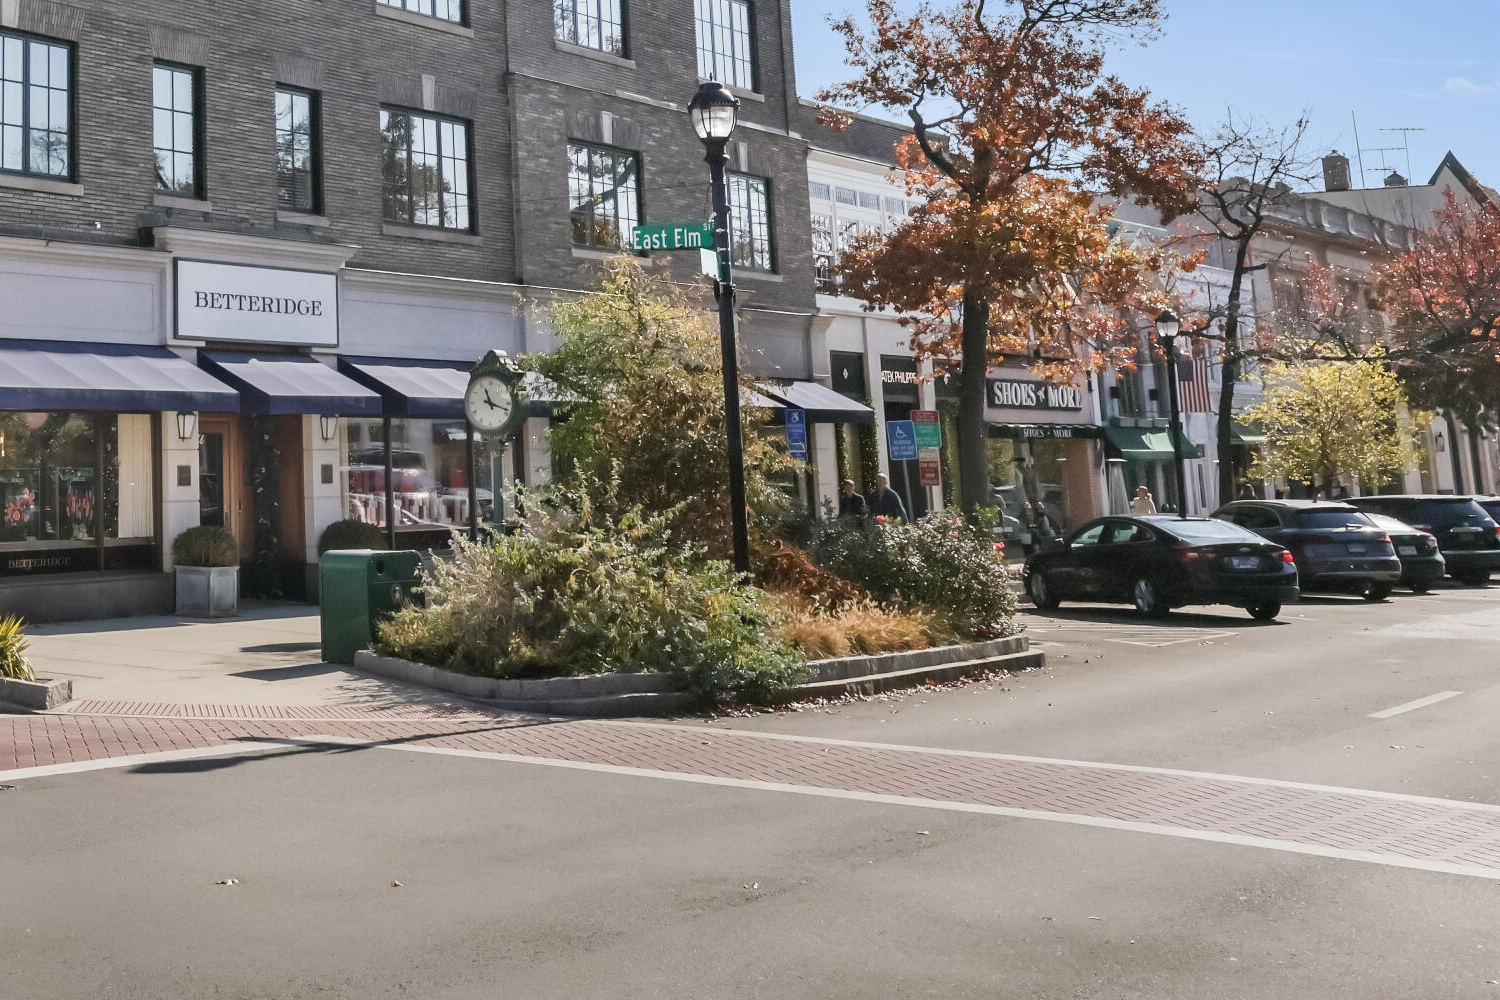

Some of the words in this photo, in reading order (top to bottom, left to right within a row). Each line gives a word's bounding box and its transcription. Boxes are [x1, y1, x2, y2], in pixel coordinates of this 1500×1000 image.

[633, 229, 667, 250] East
[674, 228, 702, 248] Elm
[194, 290, 323, 317] BETTERIDGE
[993, 381, 1037, 407] SHOES
[1047, 385, 1084, 408] MORE
[1023, 428, 1045, 438] SHOES
[1053, 429, 1073, 438] MORE
